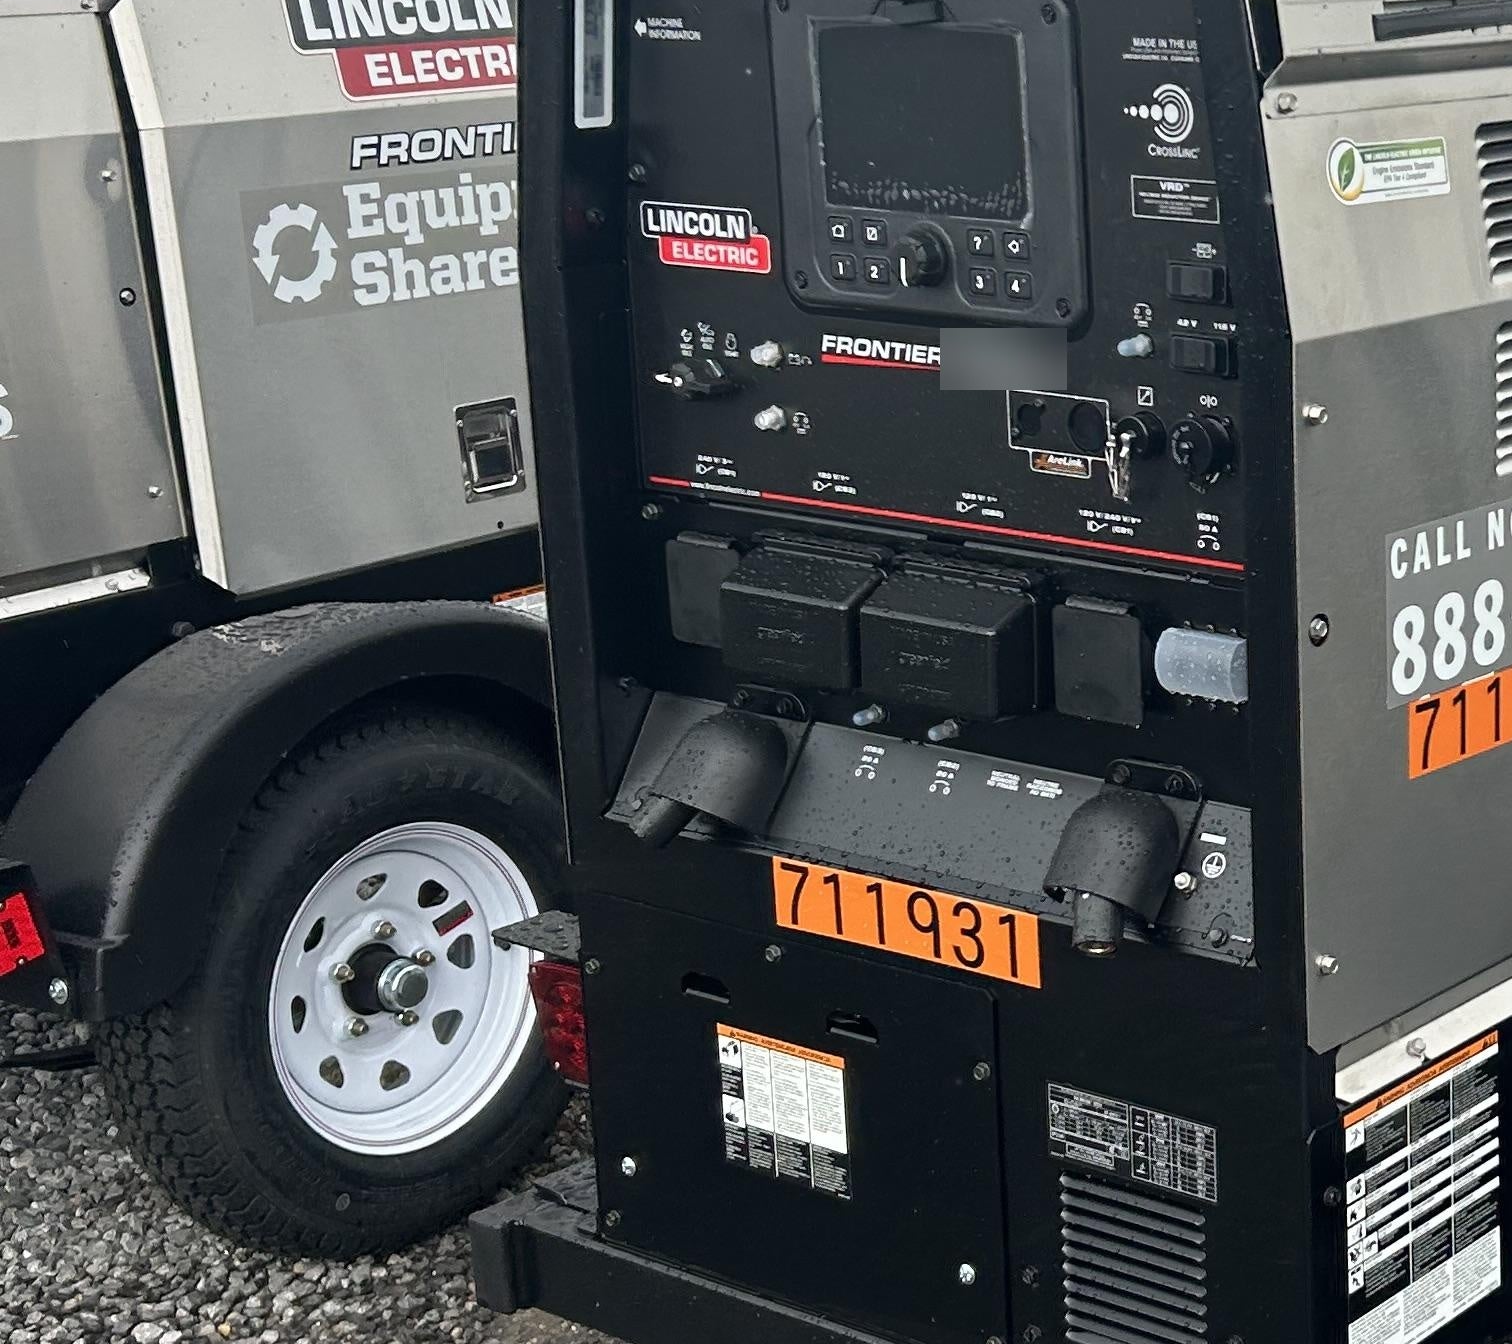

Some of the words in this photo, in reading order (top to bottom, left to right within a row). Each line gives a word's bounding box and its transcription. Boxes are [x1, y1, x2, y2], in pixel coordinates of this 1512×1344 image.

[646, 208, 745, 239] LINCOLN
[672, 240, 759, 266] ELECTRIC
[350, 246, 518, 306] Share
[821, 334, 941, 365] FRONTIER
[1391, 520, 1471, 579] CALL
[780, 862, 1018, 979] 711931
